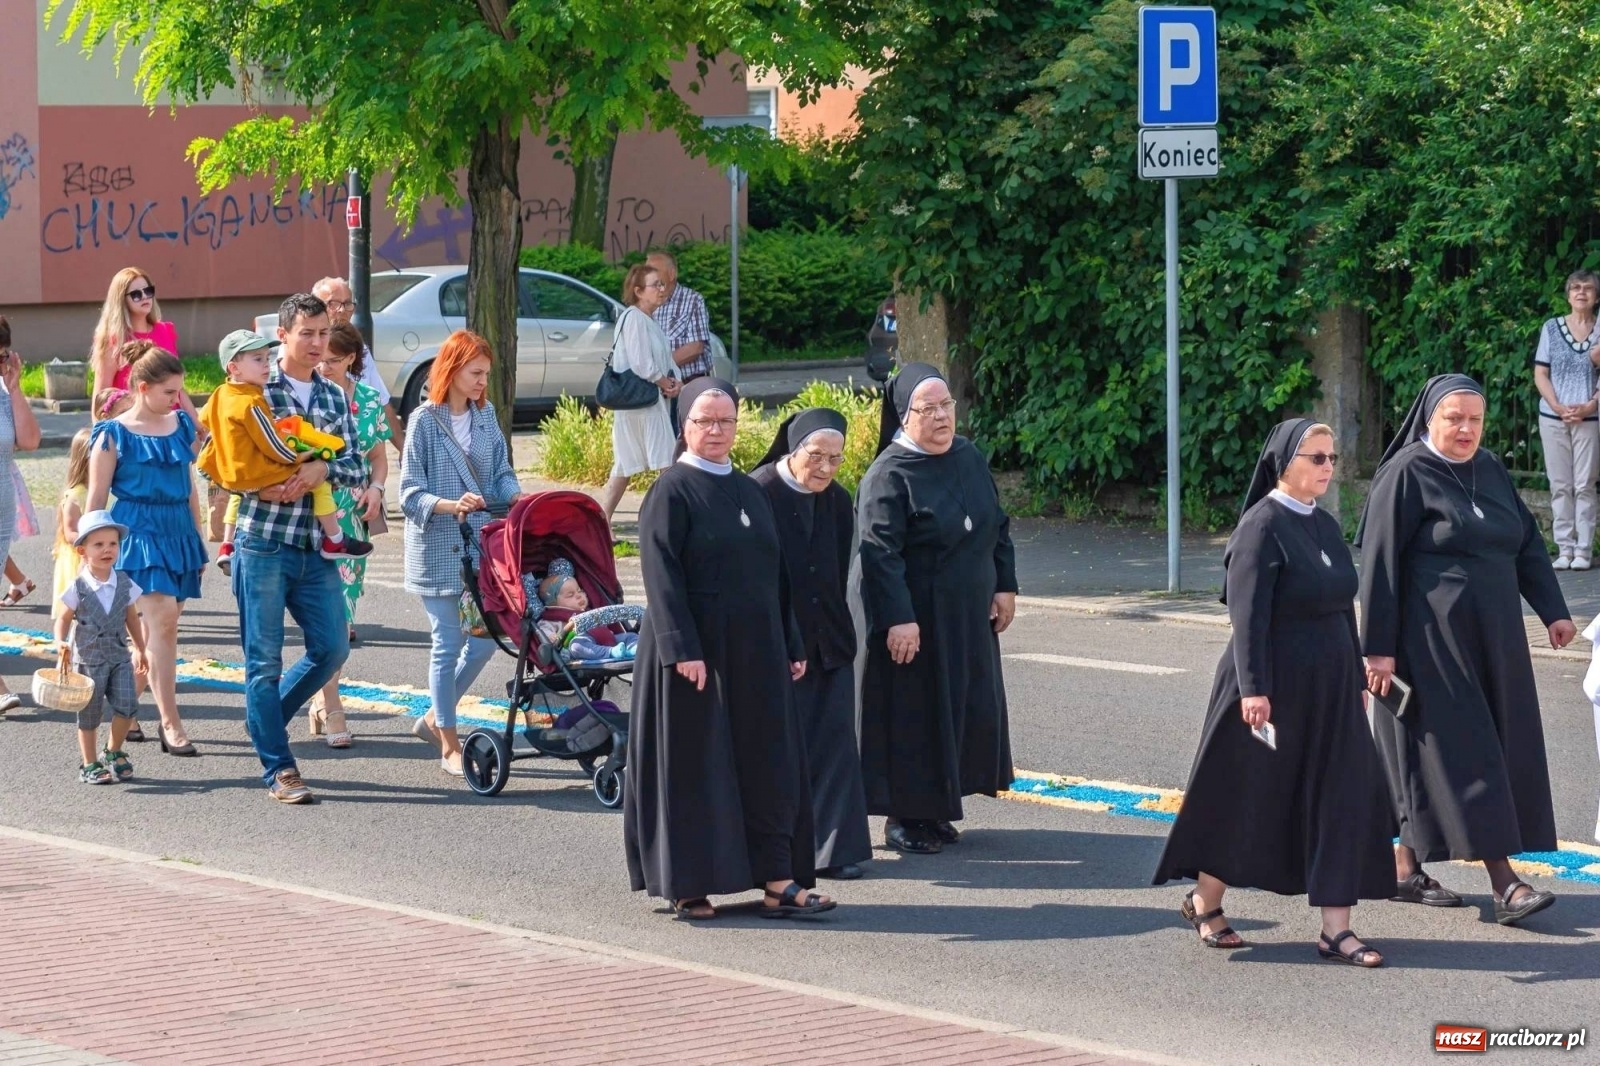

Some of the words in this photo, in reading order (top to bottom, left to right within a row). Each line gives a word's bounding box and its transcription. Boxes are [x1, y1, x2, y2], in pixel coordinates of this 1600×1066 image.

[1159, 22, 1201, 111] P
[1143, 140, 1217, 168] Koniec
[617, 197, 654, 222] TO
